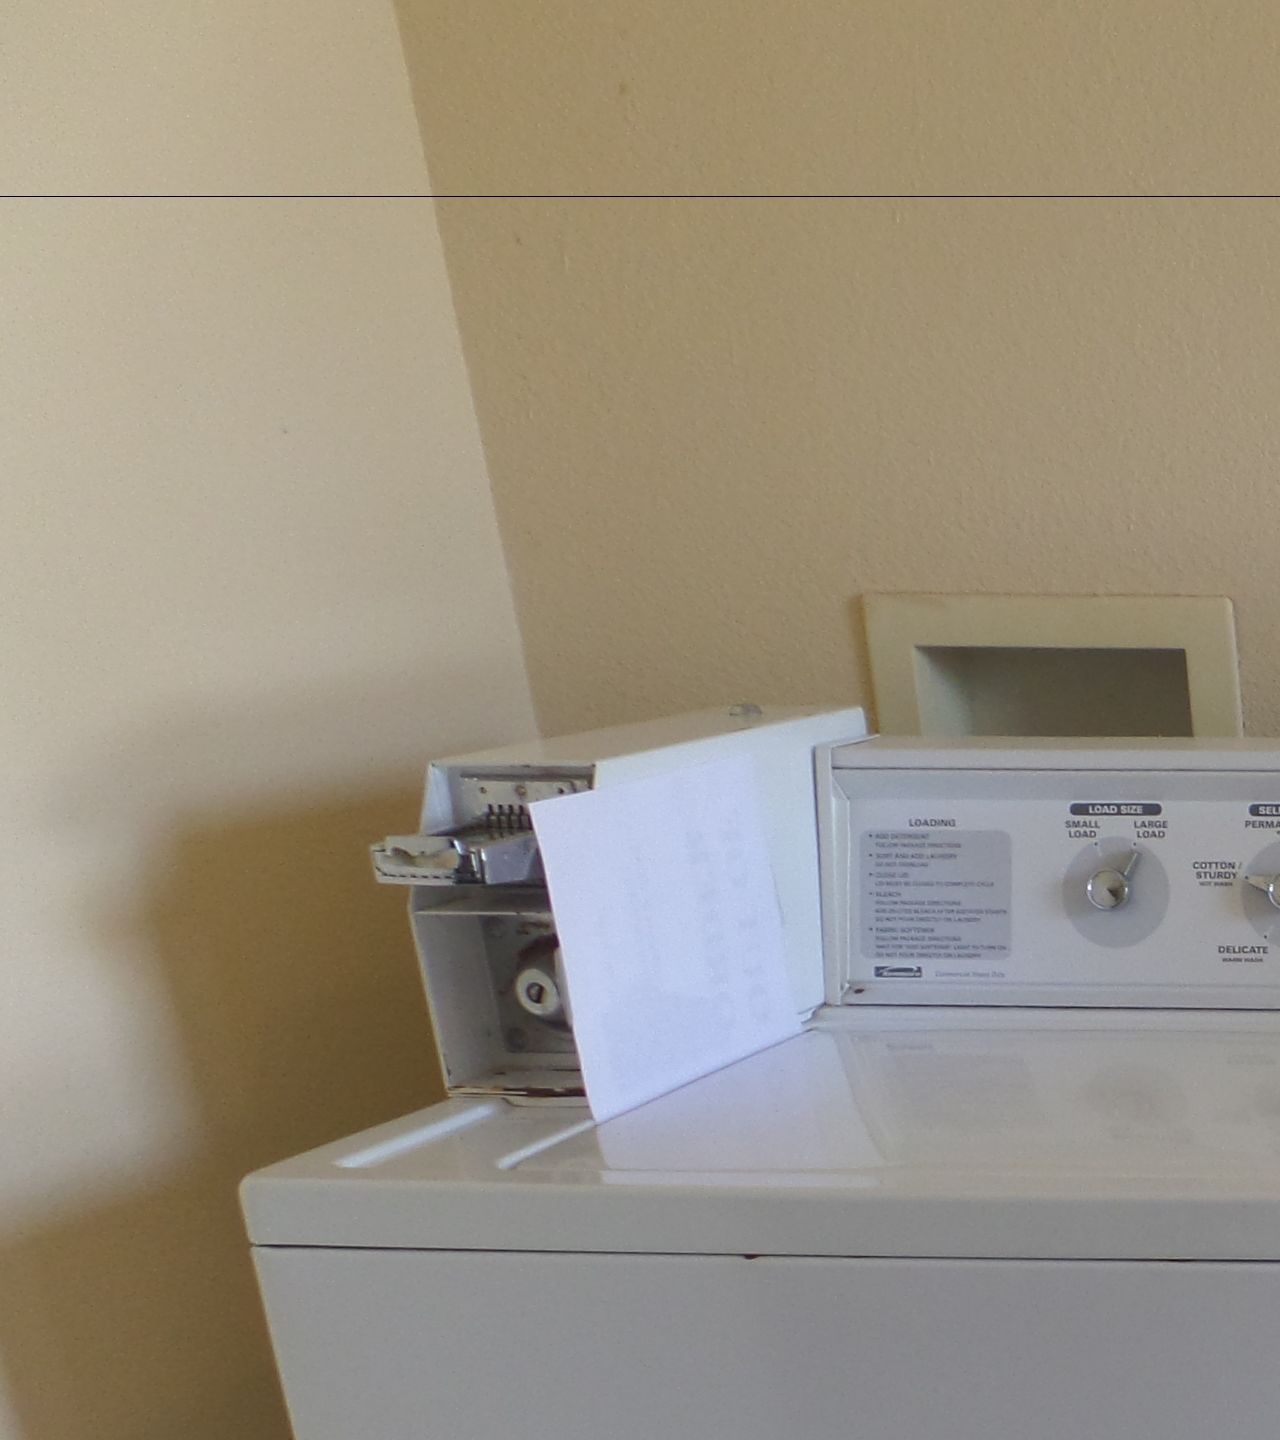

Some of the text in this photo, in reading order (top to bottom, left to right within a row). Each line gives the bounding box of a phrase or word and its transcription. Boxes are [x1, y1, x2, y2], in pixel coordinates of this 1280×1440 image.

[1088, 805, 1144, 814] LOAD SIZE
[908, 818, 957, 828] LOADING
[1064, 820, 1101, 829] SMALL
[1133, 820, 1169, 829] LARGE
[1068, 830, 1097, 838] LOAD
[1136, 830, 1166, 838] LOAD
[1192, 861, 1236, 870] COTTON
[1195, 871, 1238, 880] STURDY
[1218, 945, 1269, 954] DELICATE
